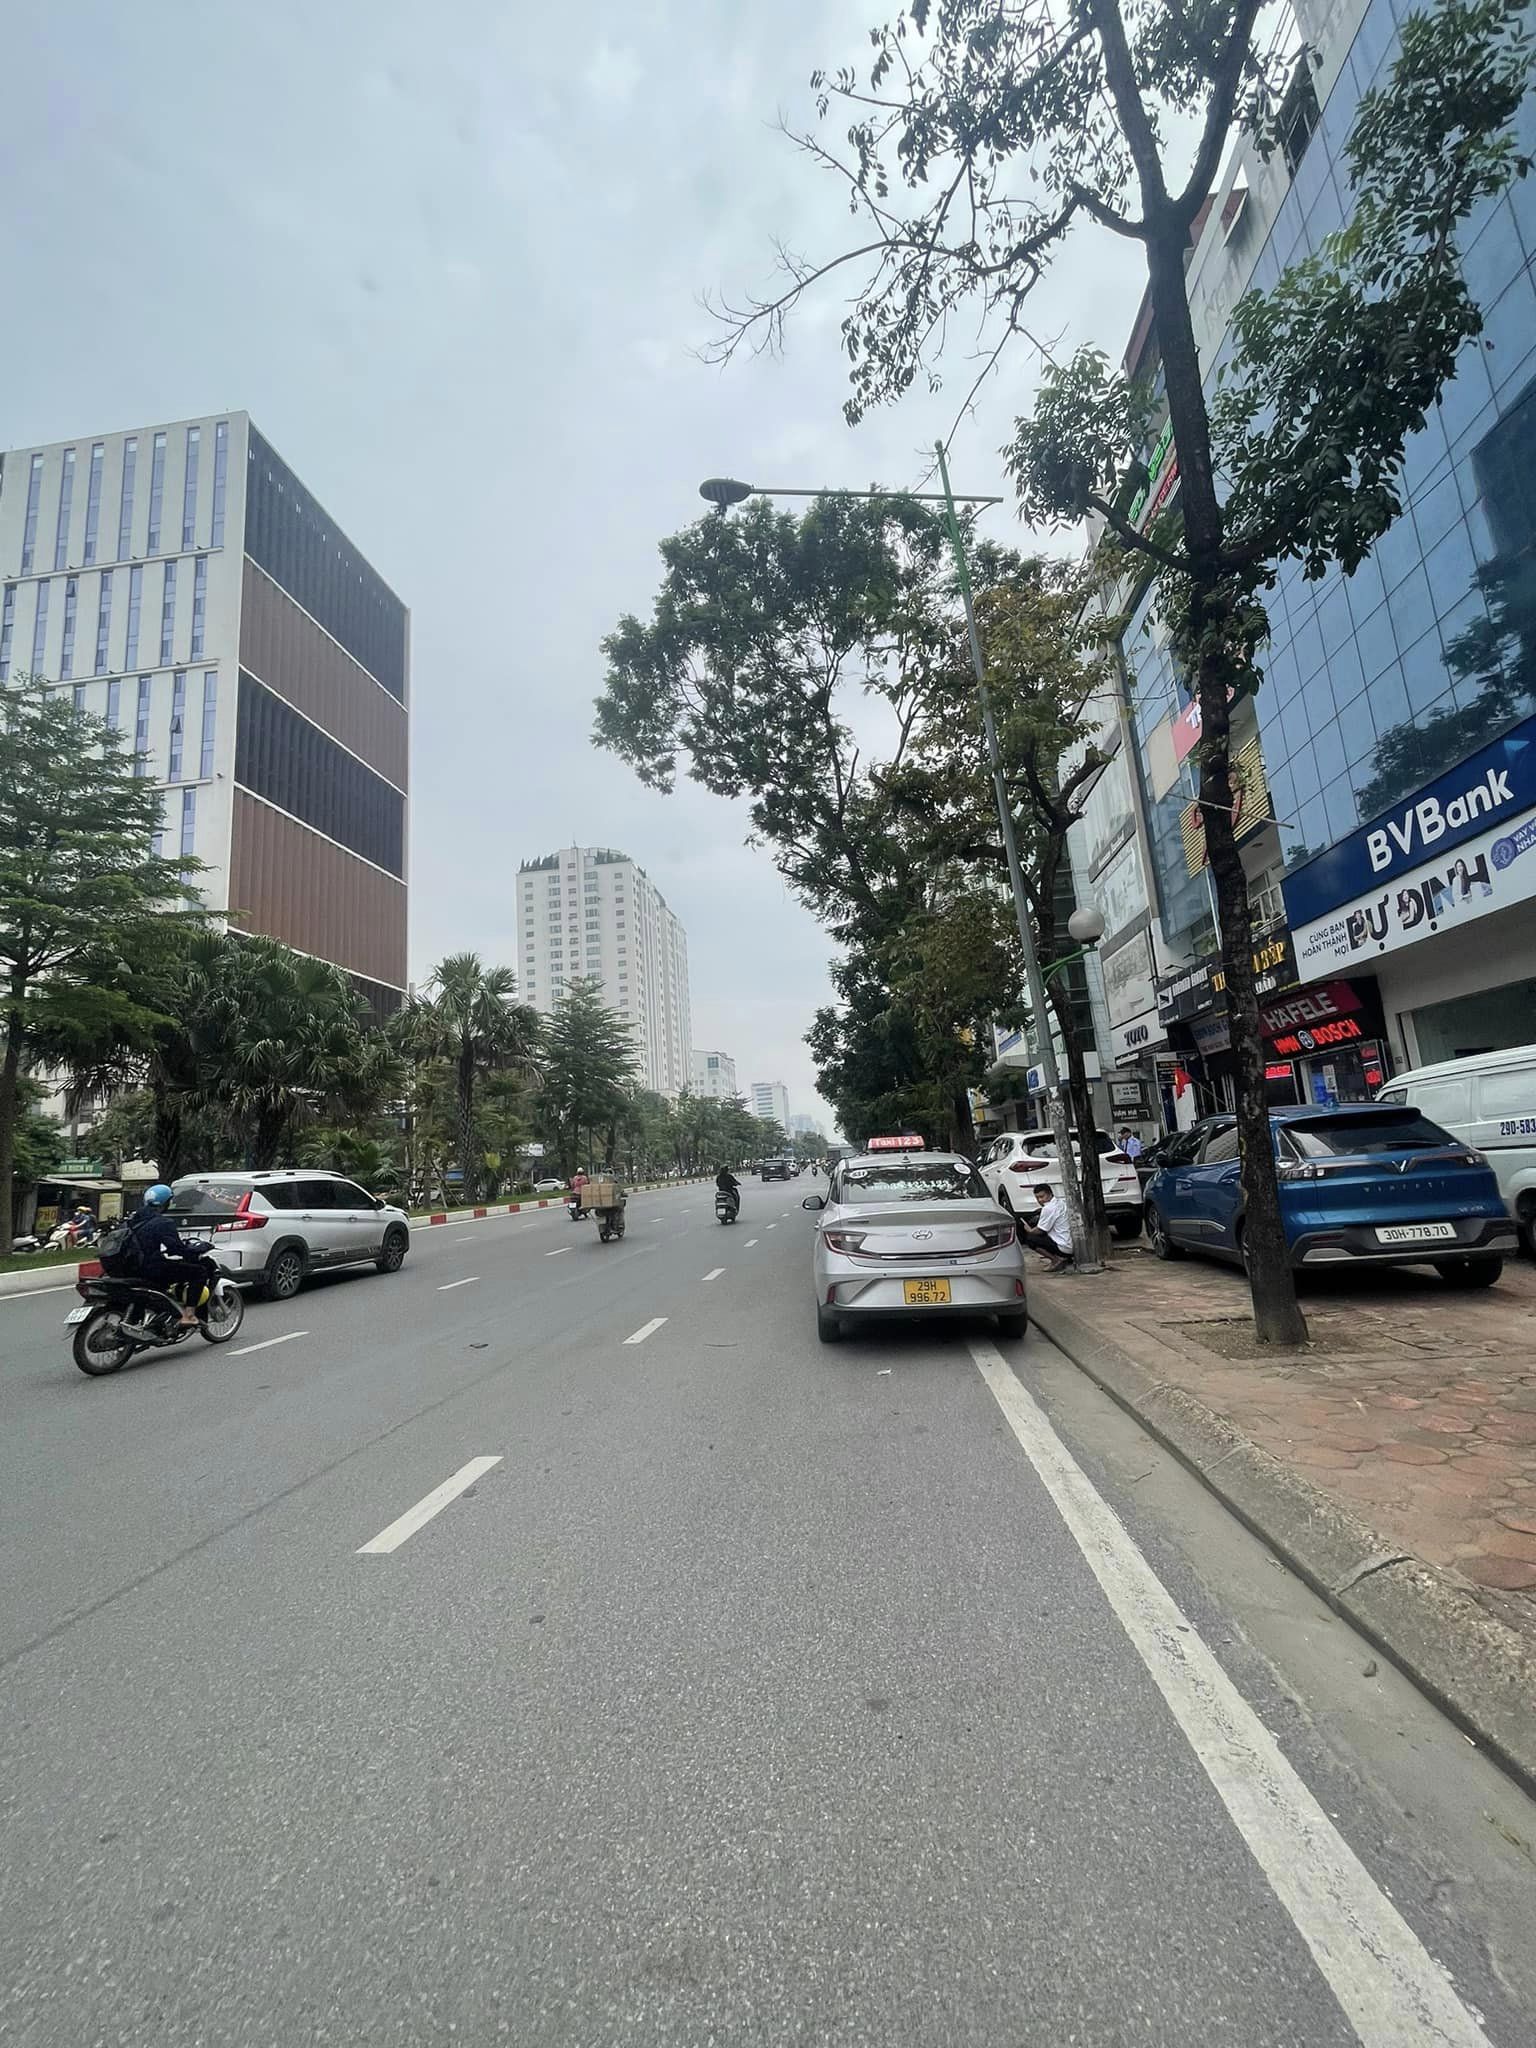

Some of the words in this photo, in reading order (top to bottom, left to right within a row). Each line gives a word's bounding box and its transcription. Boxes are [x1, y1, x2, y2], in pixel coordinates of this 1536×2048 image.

[1366, 768, 1514, 872] BVBank
[1311, 1019, 1362, 1045] BOSCH
[917, 1281, 937, 1292] 29H
[910, 1291, 946, 1303] 996.72
